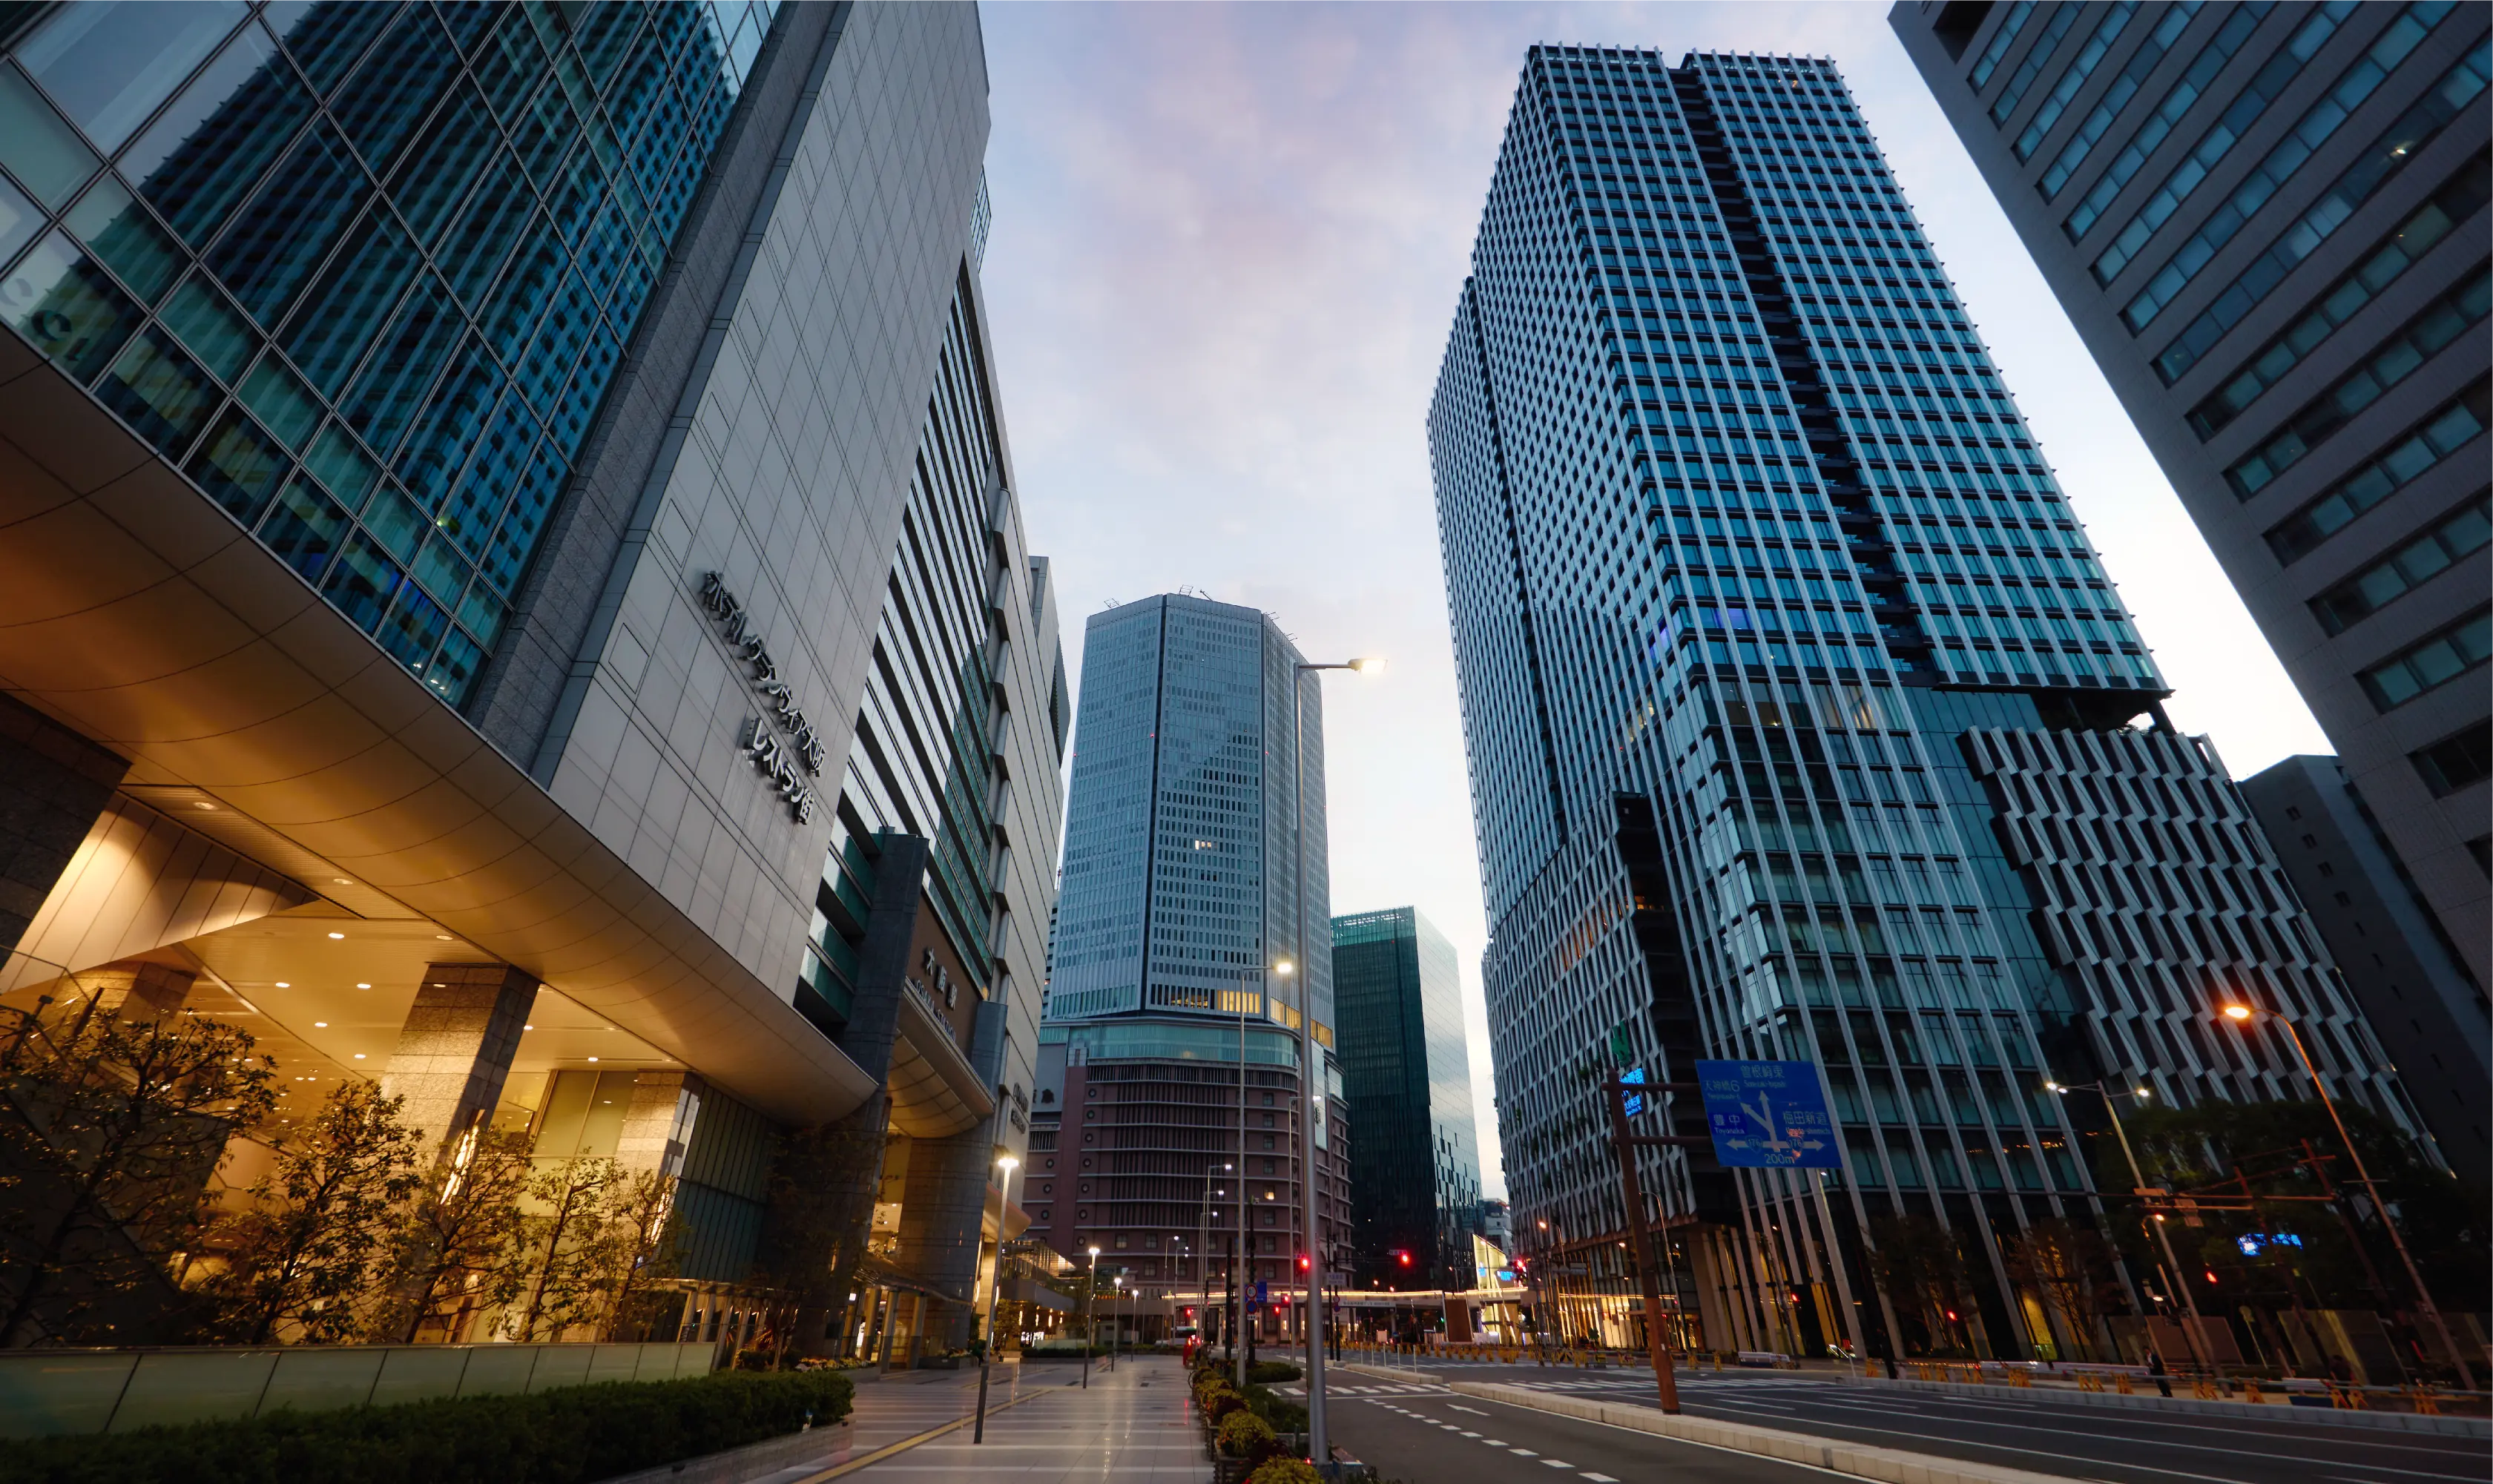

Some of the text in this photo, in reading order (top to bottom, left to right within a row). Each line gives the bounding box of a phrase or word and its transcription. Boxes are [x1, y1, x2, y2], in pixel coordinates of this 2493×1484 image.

[707, 570, 826, 772] ホテルグランヴィア大阪
[753, 717, 815, 822] レストラン街
[926, 948, 958, 1009] 大阪駅
[916, 979, 956, 1042] OSAKA STATION
[1782, 1111, 1829, 1125] 梅田新道
[1714, 1127, 1745, 1135] Toyonaka
[1748, 1138, 1760, 1147] 176
[1788, 1138, 1802, 1147] 176
[1765, 1153, 1796, 1164] 200m
